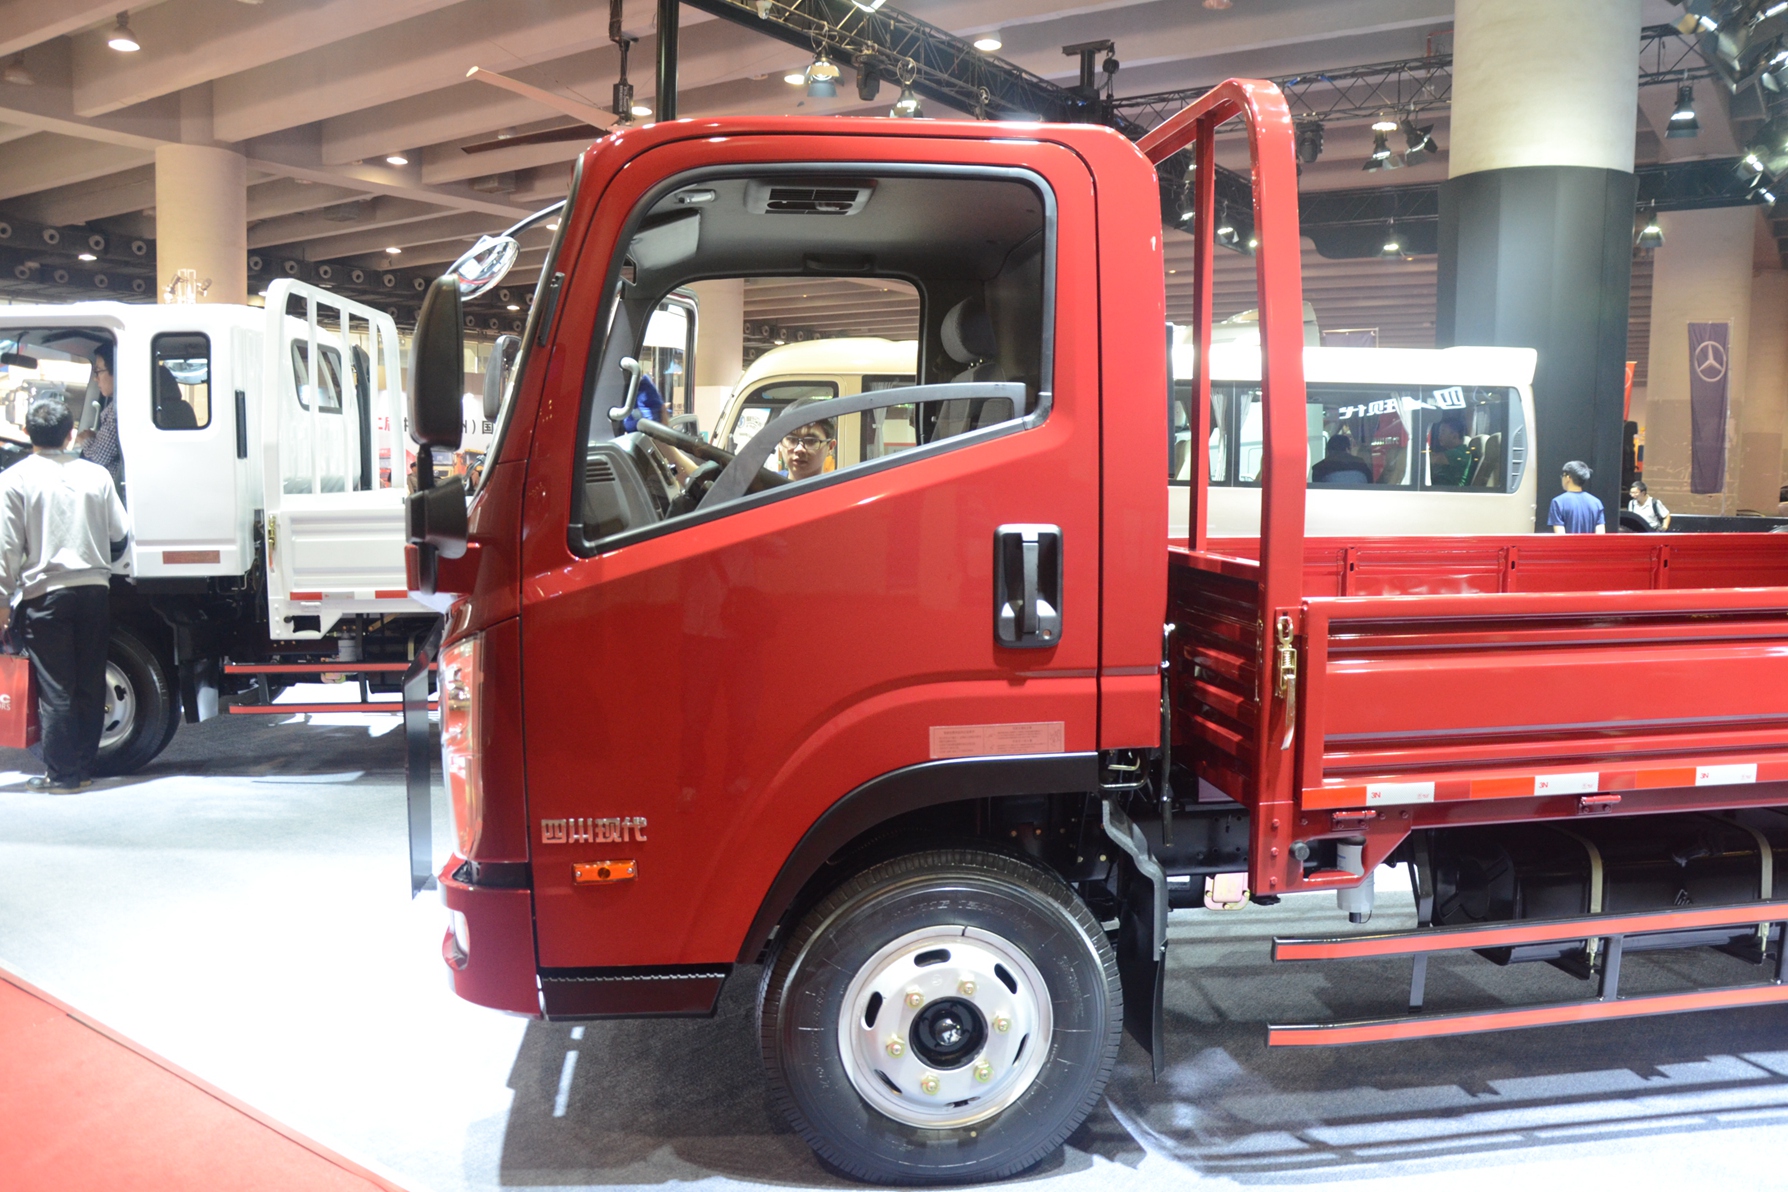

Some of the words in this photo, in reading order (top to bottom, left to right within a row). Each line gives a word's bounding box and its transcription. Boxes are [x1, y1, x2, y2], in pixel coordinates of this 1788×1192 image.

[0, 693, 11, 704] C
[541, 816, 648, 844] 四川现代
